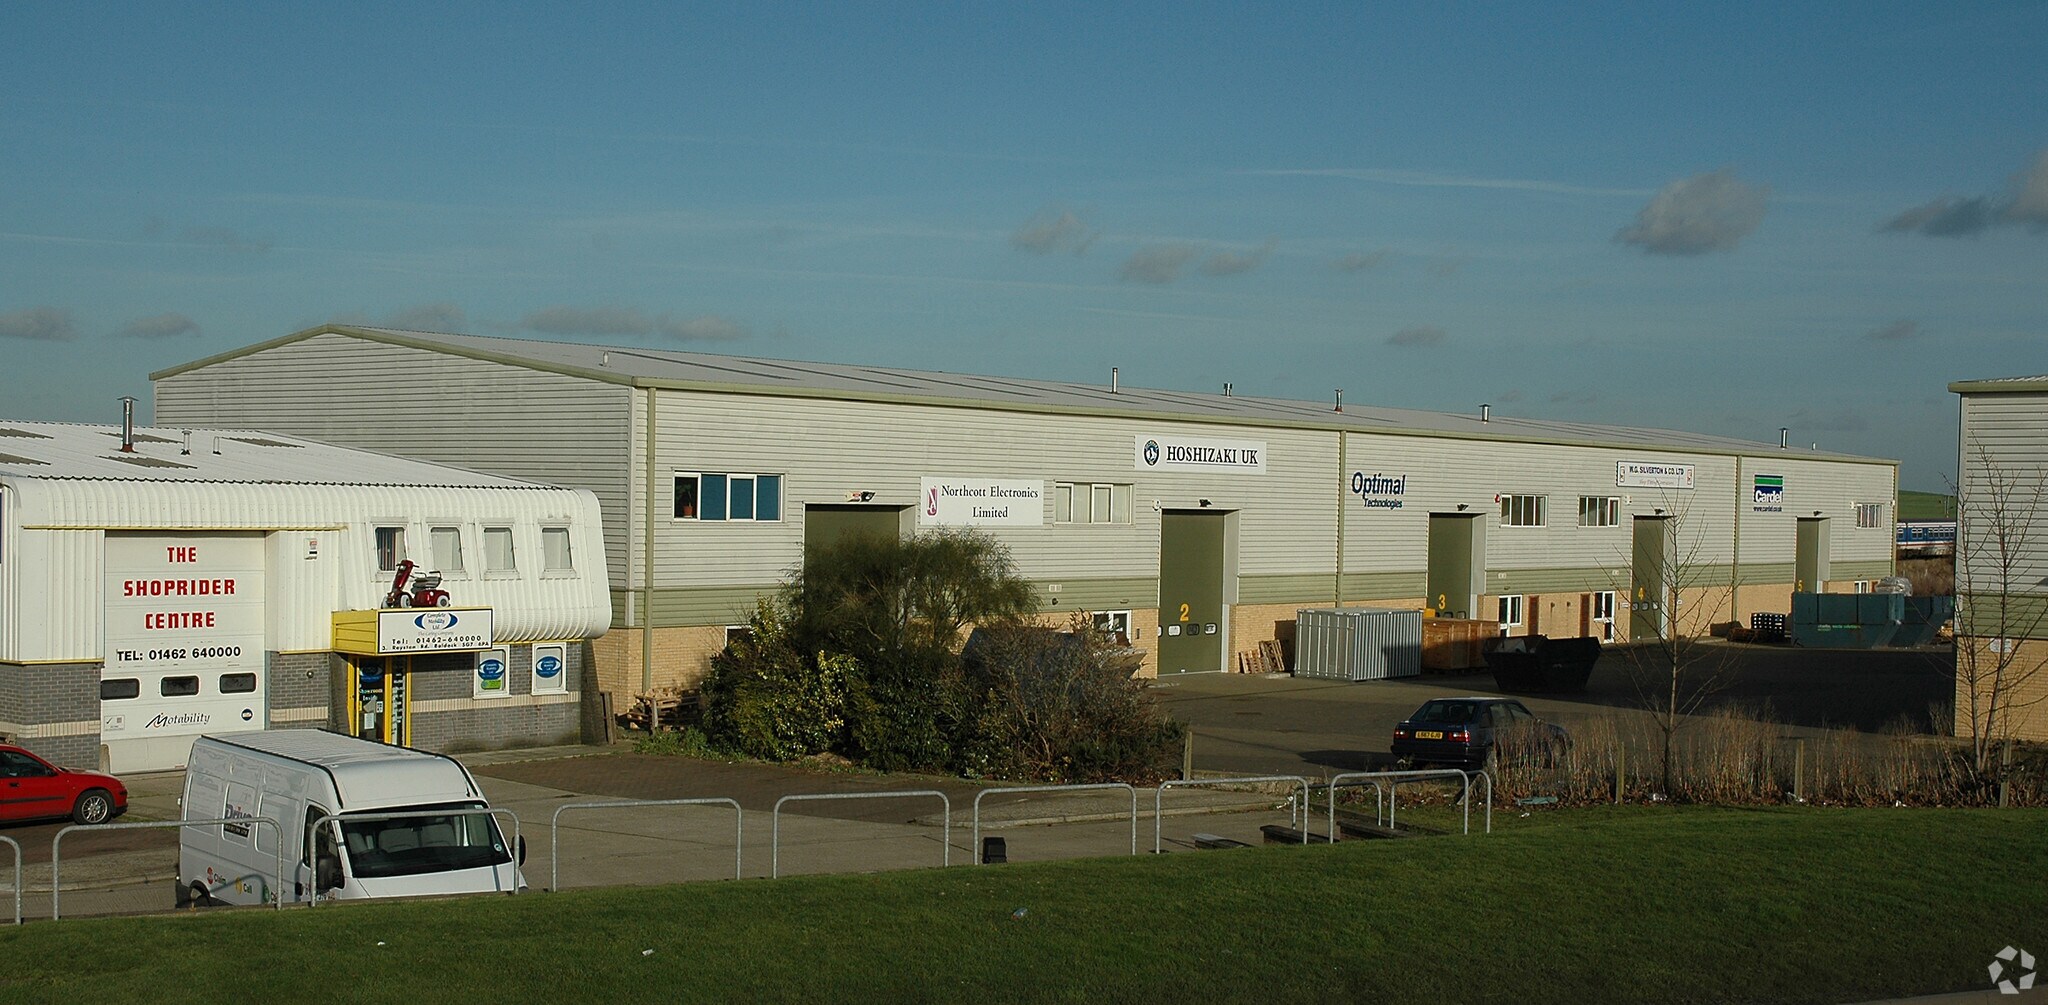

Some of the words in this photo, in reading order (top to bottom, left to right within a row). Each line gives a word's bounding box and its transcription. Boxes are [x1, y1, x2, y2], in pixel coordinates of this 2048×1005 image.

[1166, 445, 1237, 463] HOSHIZAKI
[1241, 449, 1258, 465] UK
[1676, 468, 1684, 476] LTD
[941, 484, 986, 497] Northcott
[990, 485, 1039, 498] Electronics
[1351, 471, 1406, 500] Optimal
[1364, 498, 1403, 510] Technologies
[1755, 490, 1782, 503] Cardel
[972, 506, 1008, 518] Limited
[166, 546, 197, 563] THE
[123, 578, 236, 597] SHOPRIDER
[1638, 587, 1644, 600] 4
[1438, 594, 1446, 610] 3
[1180, 603, 1189, 621] 2
[144, 612, 215, 630] CENTRE
[416, 635, 482, 644] 01462-640000
[116, 650, 143, 662] TEL:
[148, 648, 187, 660] 01462
[192, 646, 241, 659] 640000
[145, 712, 211, 729] Motability
